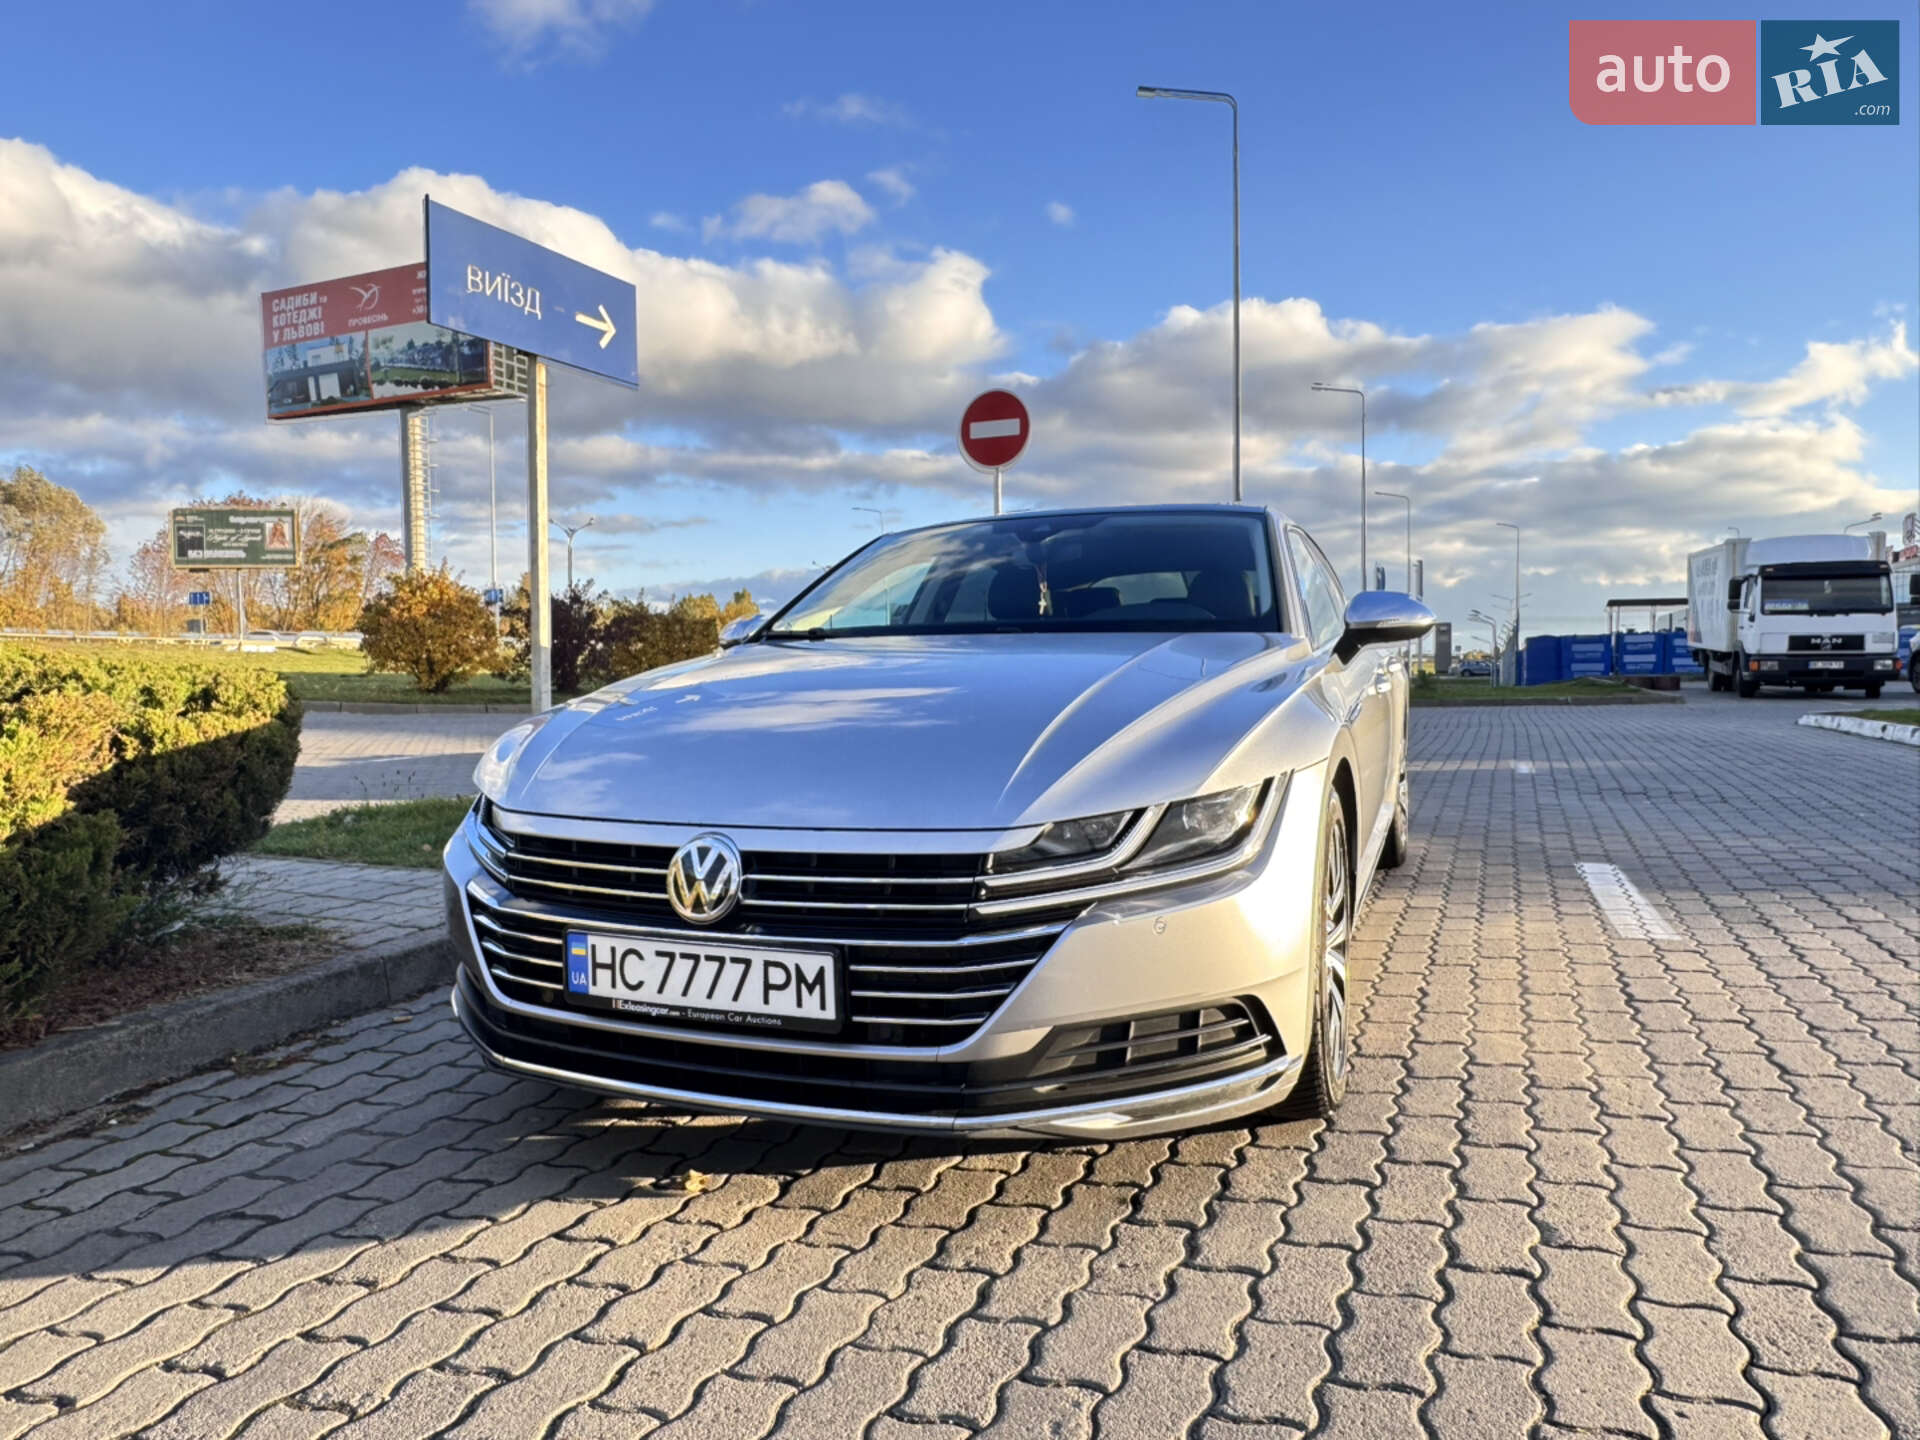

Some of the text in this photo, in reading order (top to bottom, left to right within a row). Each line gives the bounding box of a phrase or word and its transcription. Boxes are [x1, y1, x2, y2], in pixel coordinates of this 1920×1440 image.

[272, 291, 318, 313] САДИБИ
[465, 263, 542, 321] ВИЇЗД
[272, 306, 322, 329] КОТЕДЖІ
[272, 320, 325, 344] У ЛЬВОВІ
[1810, 637, 1843, 645] MAN
[571, 973, 588, 986] UA
[590, 943, 645, 992] HC
[654, 950, 753, 1002] 7777
[687, 1010, 726, 1021] European
[727, 1012, 743, 1023] Car
[745, 1015, 782, 1025] Auctions
